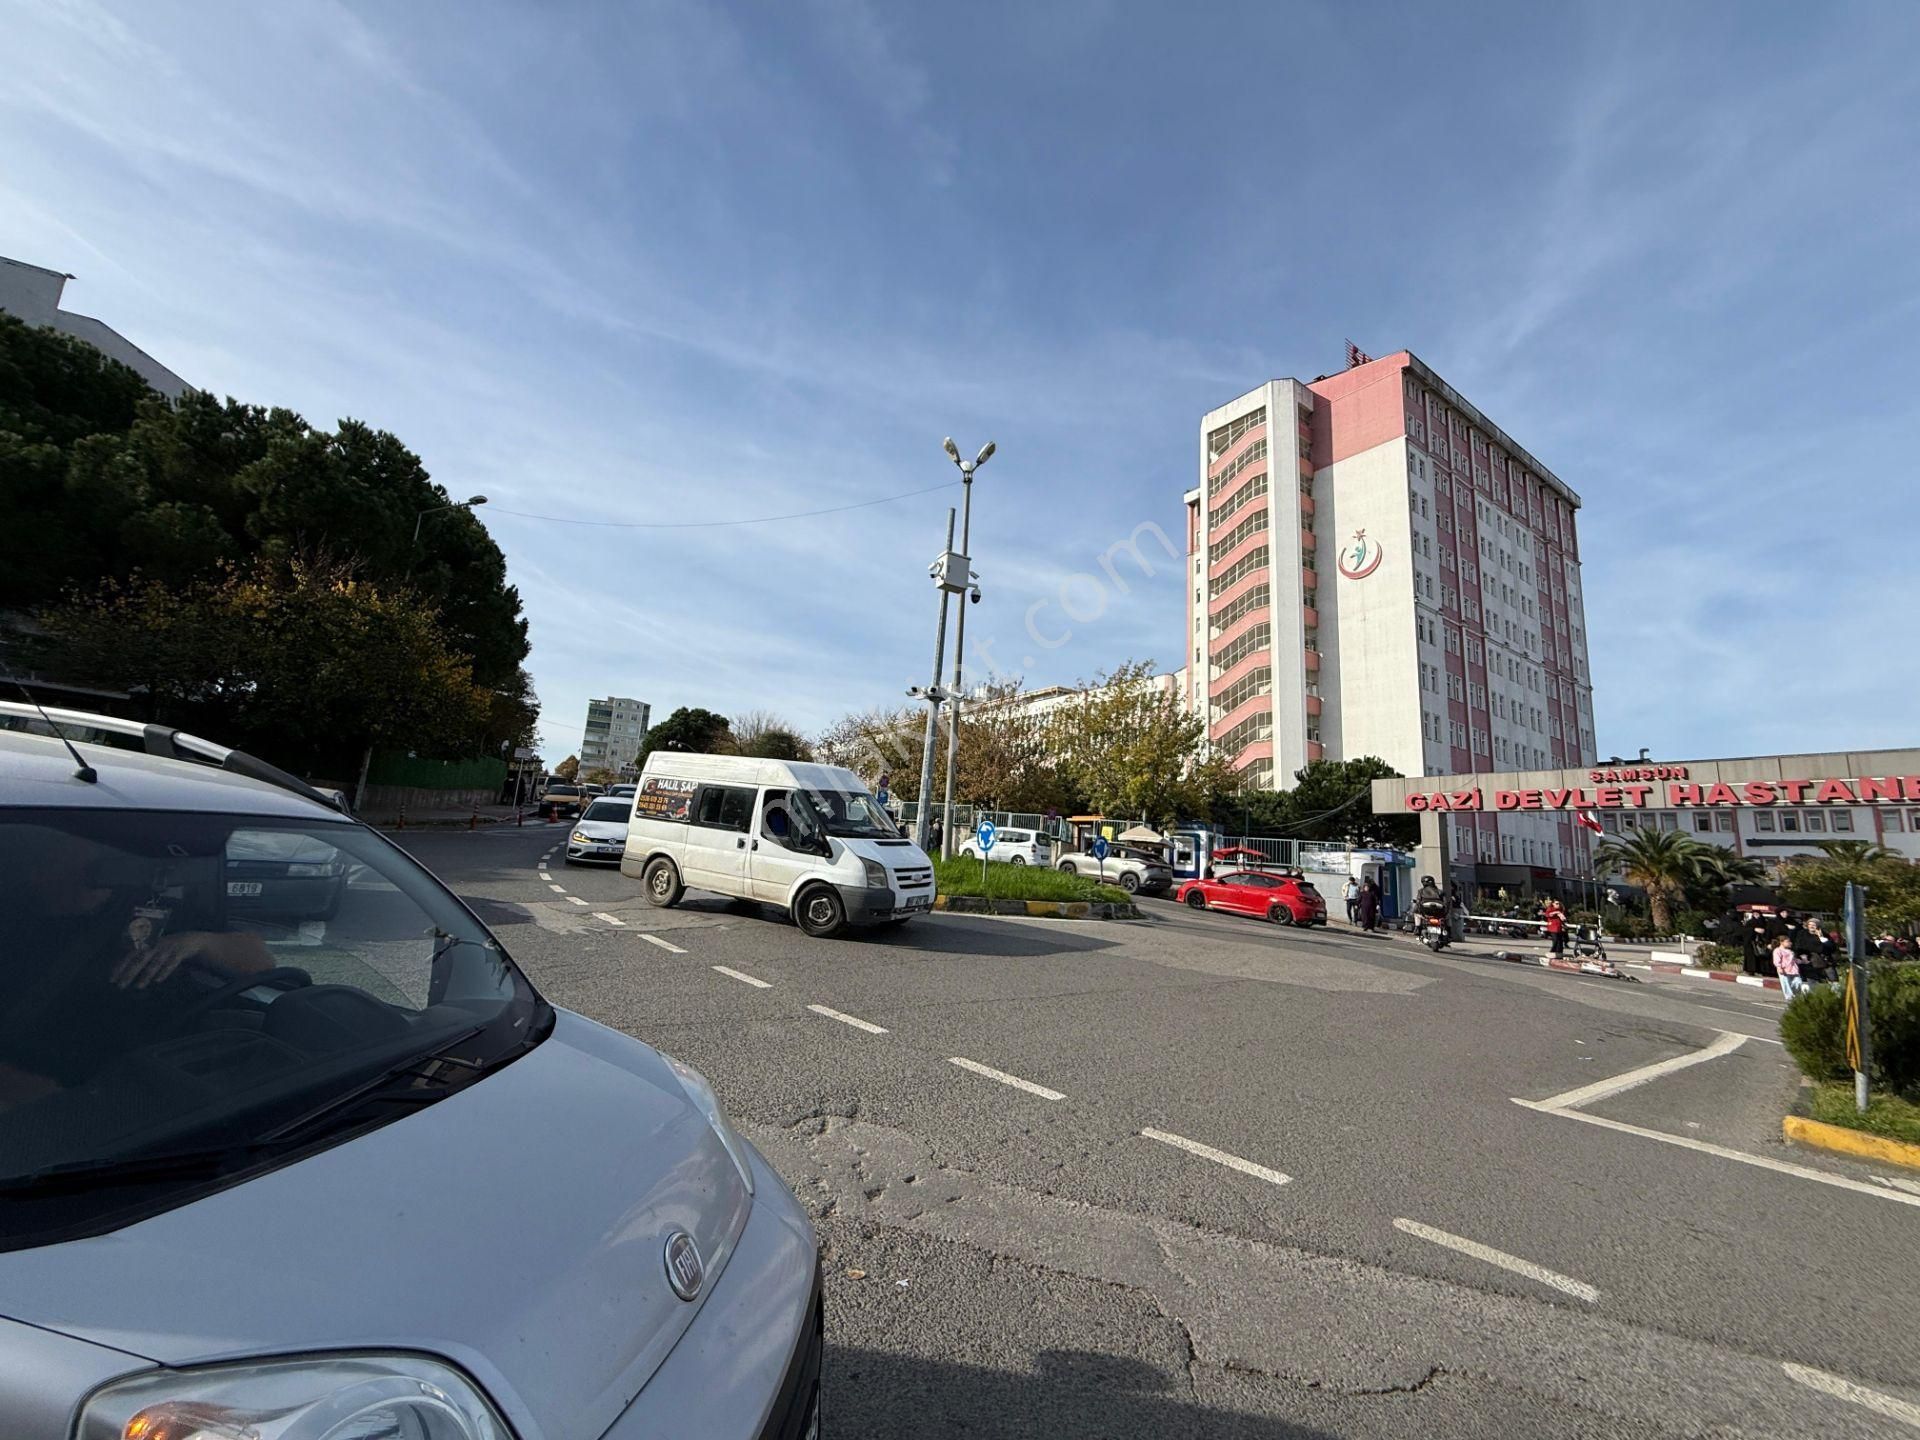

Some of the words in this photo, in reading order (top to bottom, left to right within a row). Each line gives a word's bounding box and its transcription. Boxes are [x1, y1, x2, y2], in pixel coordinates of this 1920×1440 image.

[1589, 766, 1688, 783] SAMSUN
[1406, 787, 1484, 811] GAZİ
[1495, 786, 1650, 810] DEVLET
